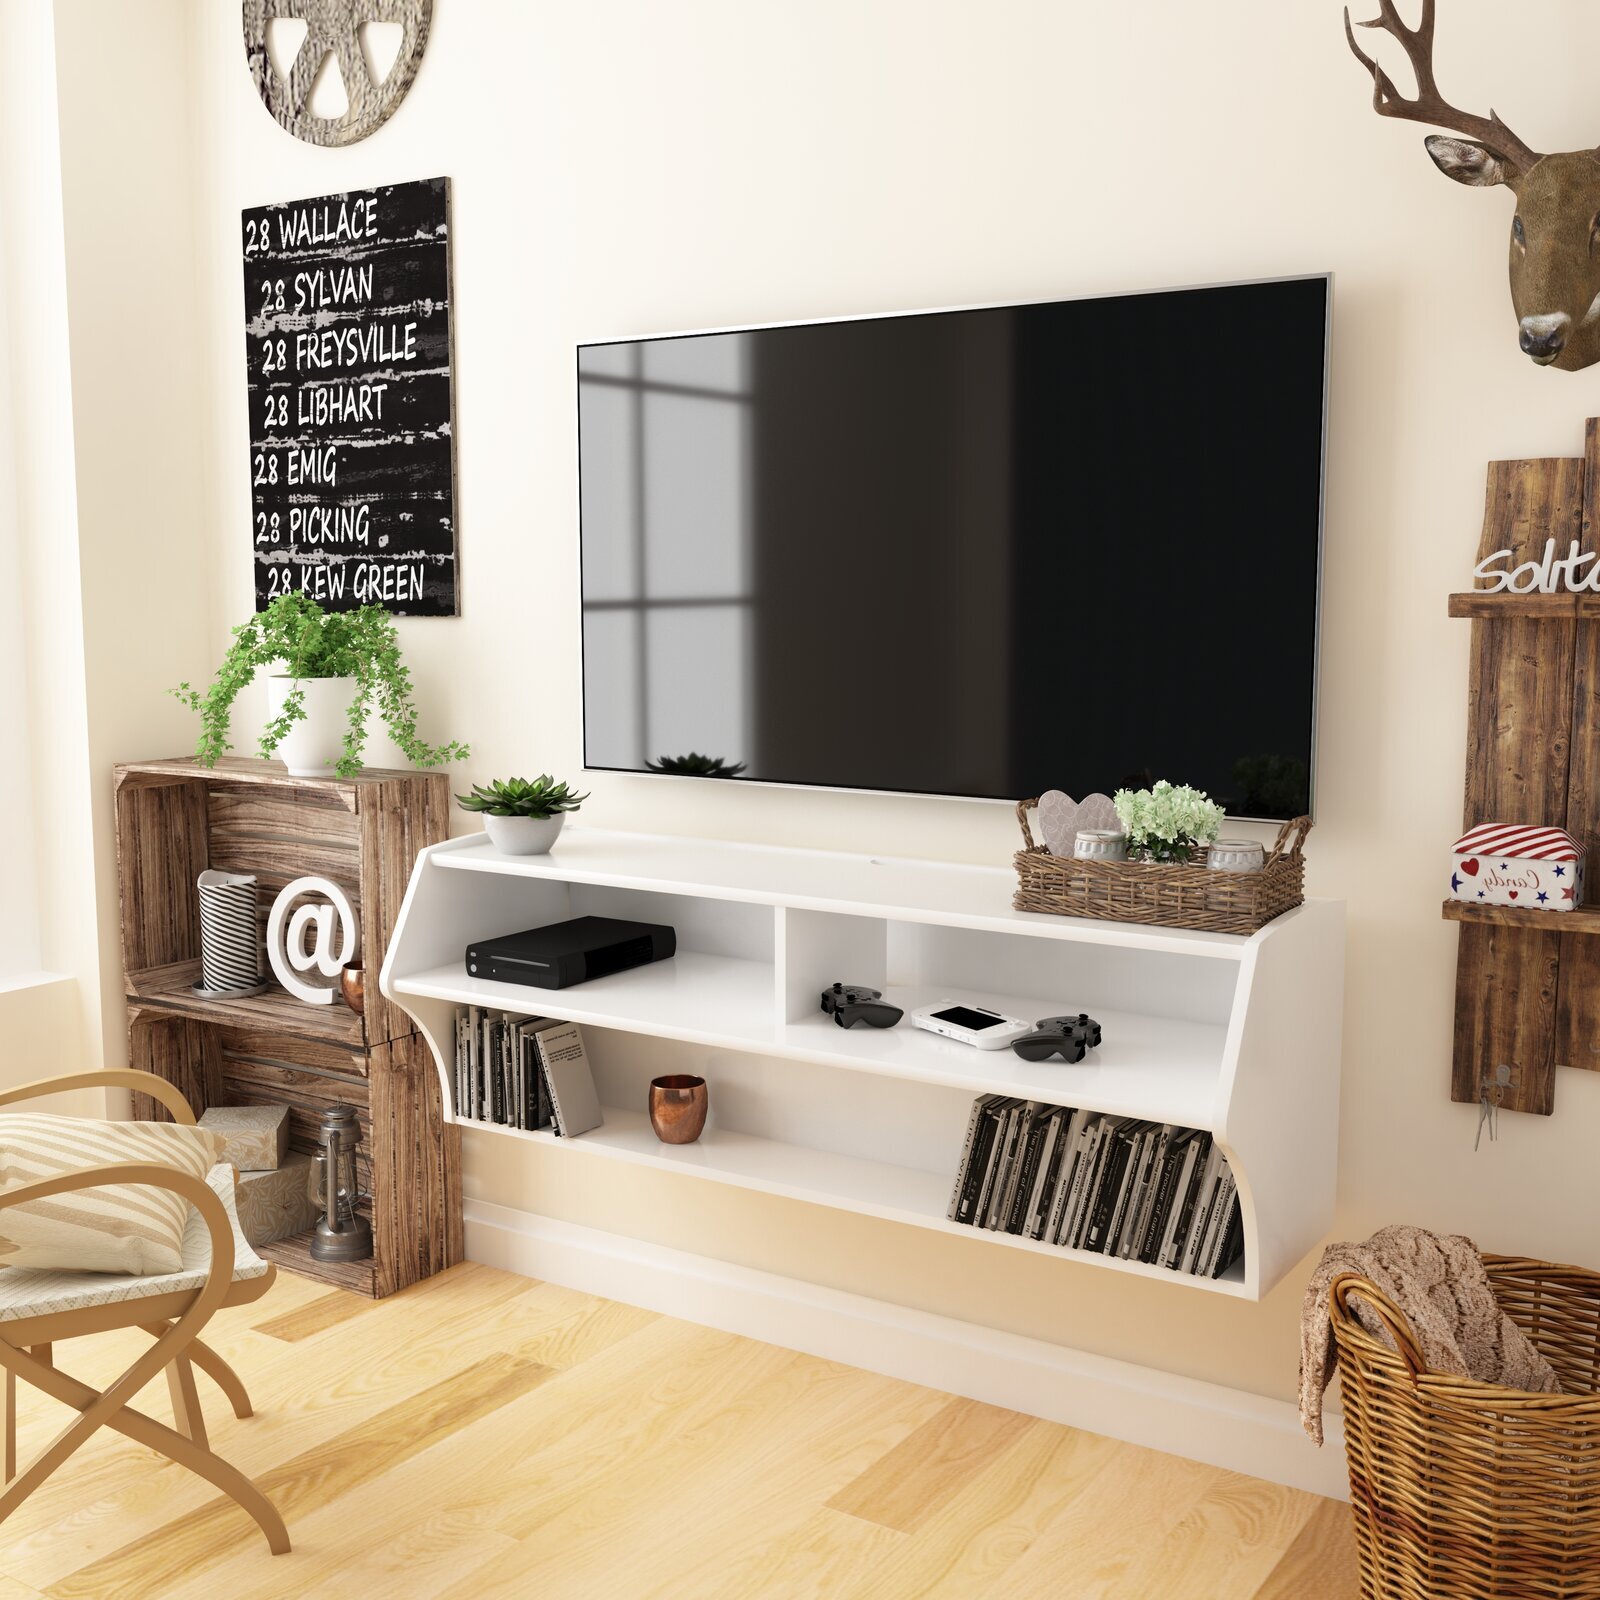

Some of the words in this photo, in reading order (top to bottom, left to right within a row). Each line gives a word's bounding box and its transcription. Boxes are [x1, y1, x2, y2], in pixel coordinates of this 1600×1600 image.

[245, 218, 270, 255] 28
[278, 198, 378, 250] WALLACE
[261, 279, 285, 314] 28
[294, 264, 373, 312] SYLVAN
[262, 339, 287, 372] 28
[296, 322, 418, 371] FREYSVILLE
[264, 394, 289, 429] 28
[298, 384, 388, 426] LIBHART
[254, 453, 278, 487] 28
[287, 446, 337, 487] EMIG
[256, 511, 281, 545] 28
[289, 504, 370, 546] PICKING
[267, 567, 292, 599] 28
[301, 563, 346, 600] KEW
[353, 563, 424, 604] GREEN
[1024, 1146, 1035, 1175] power
[951, 1158, 966, 1205] WINES
[1160, 1172, 1171, 1200] power
[1011, 1188, 1023, 1225] carnival
[1145, 1217, 1158, 1253] carnival
